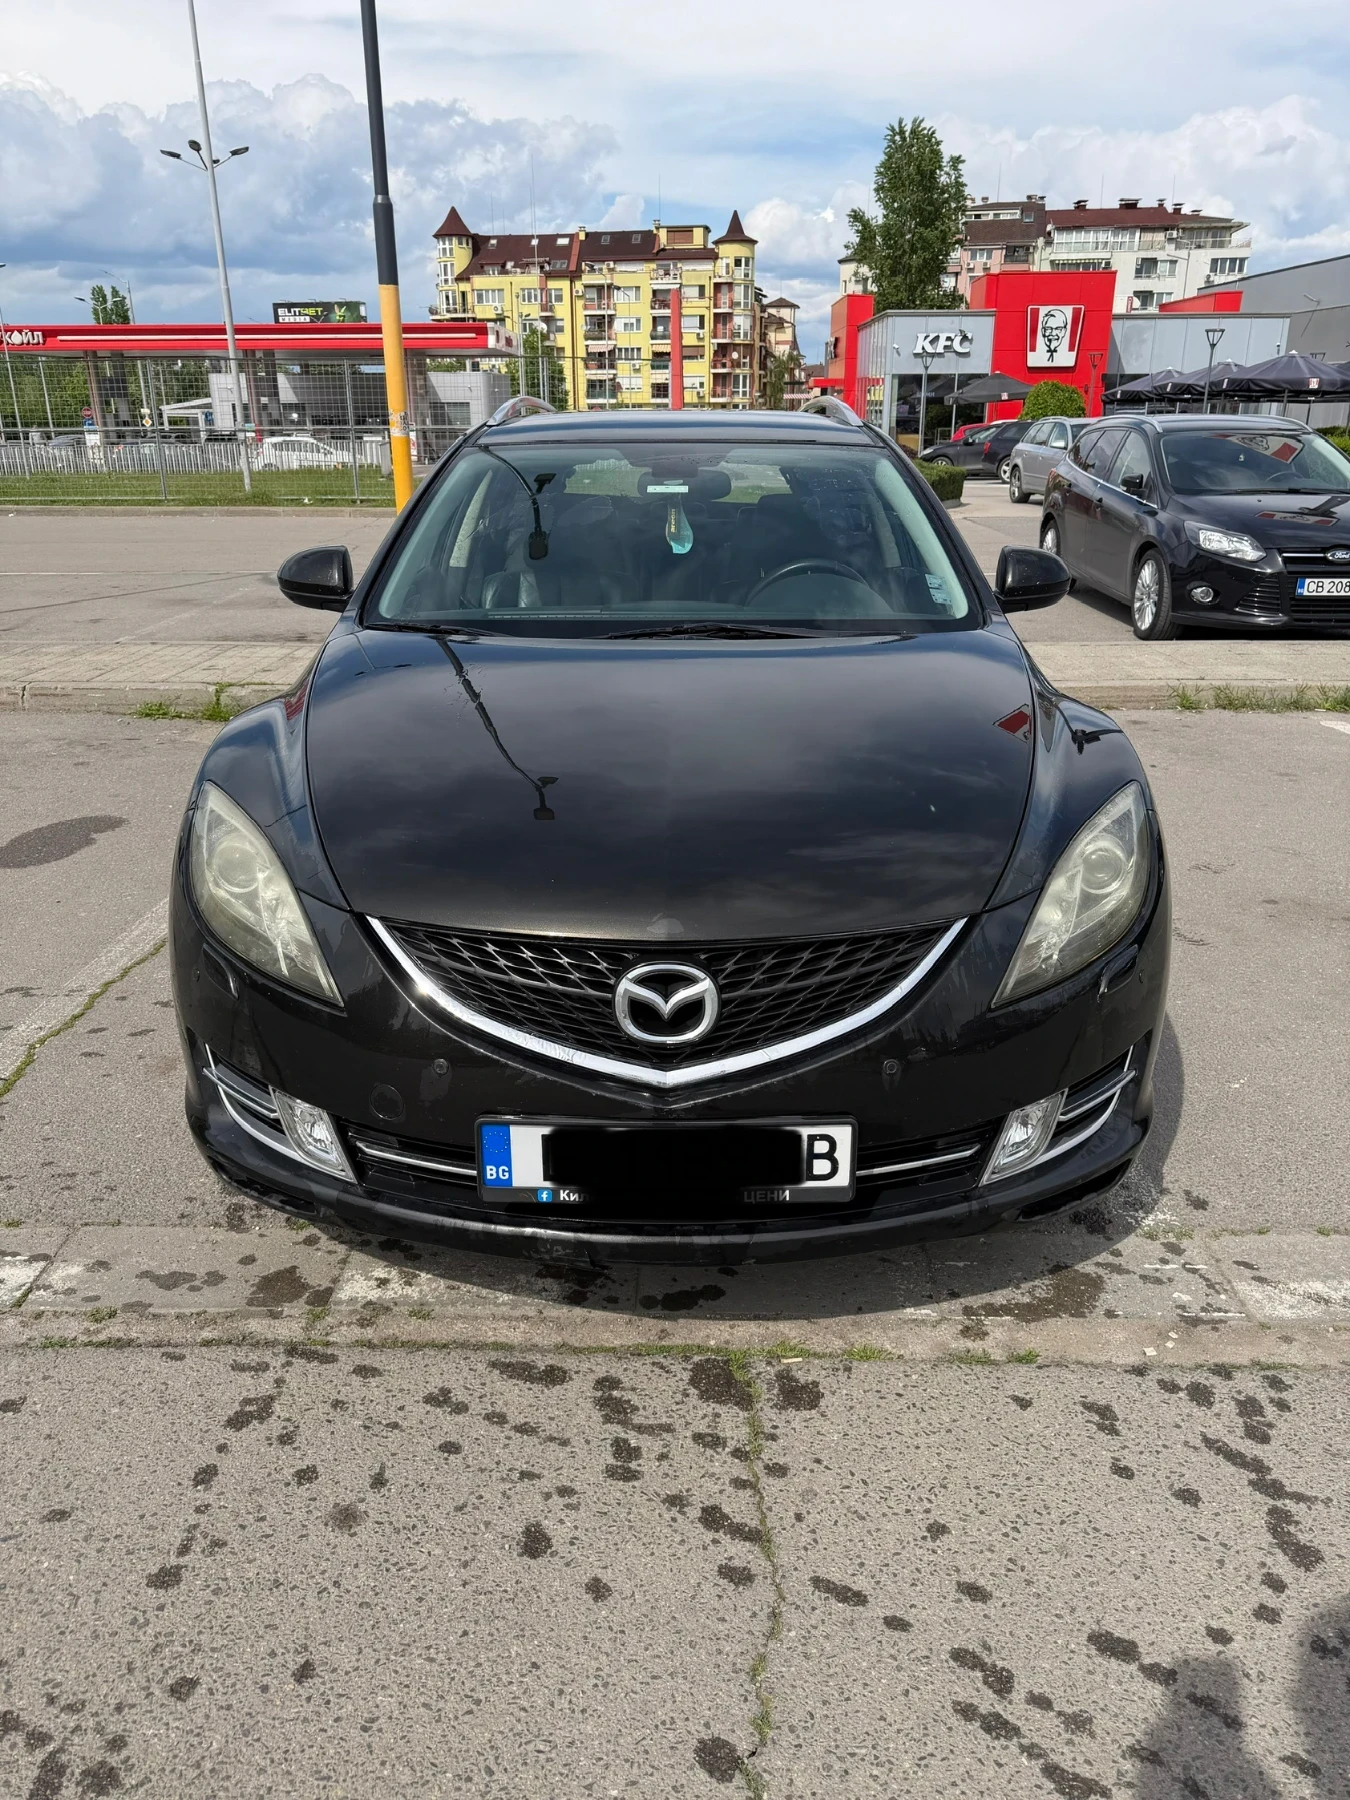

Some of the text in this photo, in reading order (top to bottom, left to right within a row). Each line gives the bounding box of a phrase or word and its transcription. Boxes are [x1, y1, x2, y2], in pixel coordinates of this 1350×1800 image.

[277, 307, 323, 316] ELITBET
[0, 329, 44, 345] КОЙЛ
[912, 332, 973, 354] KFC
[1334, 551, 1350, 559] Ford
[1307, 580, 1325, 594] CB
[1327, 580, 1350, 594] 208
[485, 1165, 510, 1180] BG
[805, 1133, 839, 1182] B
[559, 1189, 589, 1202] Кил
